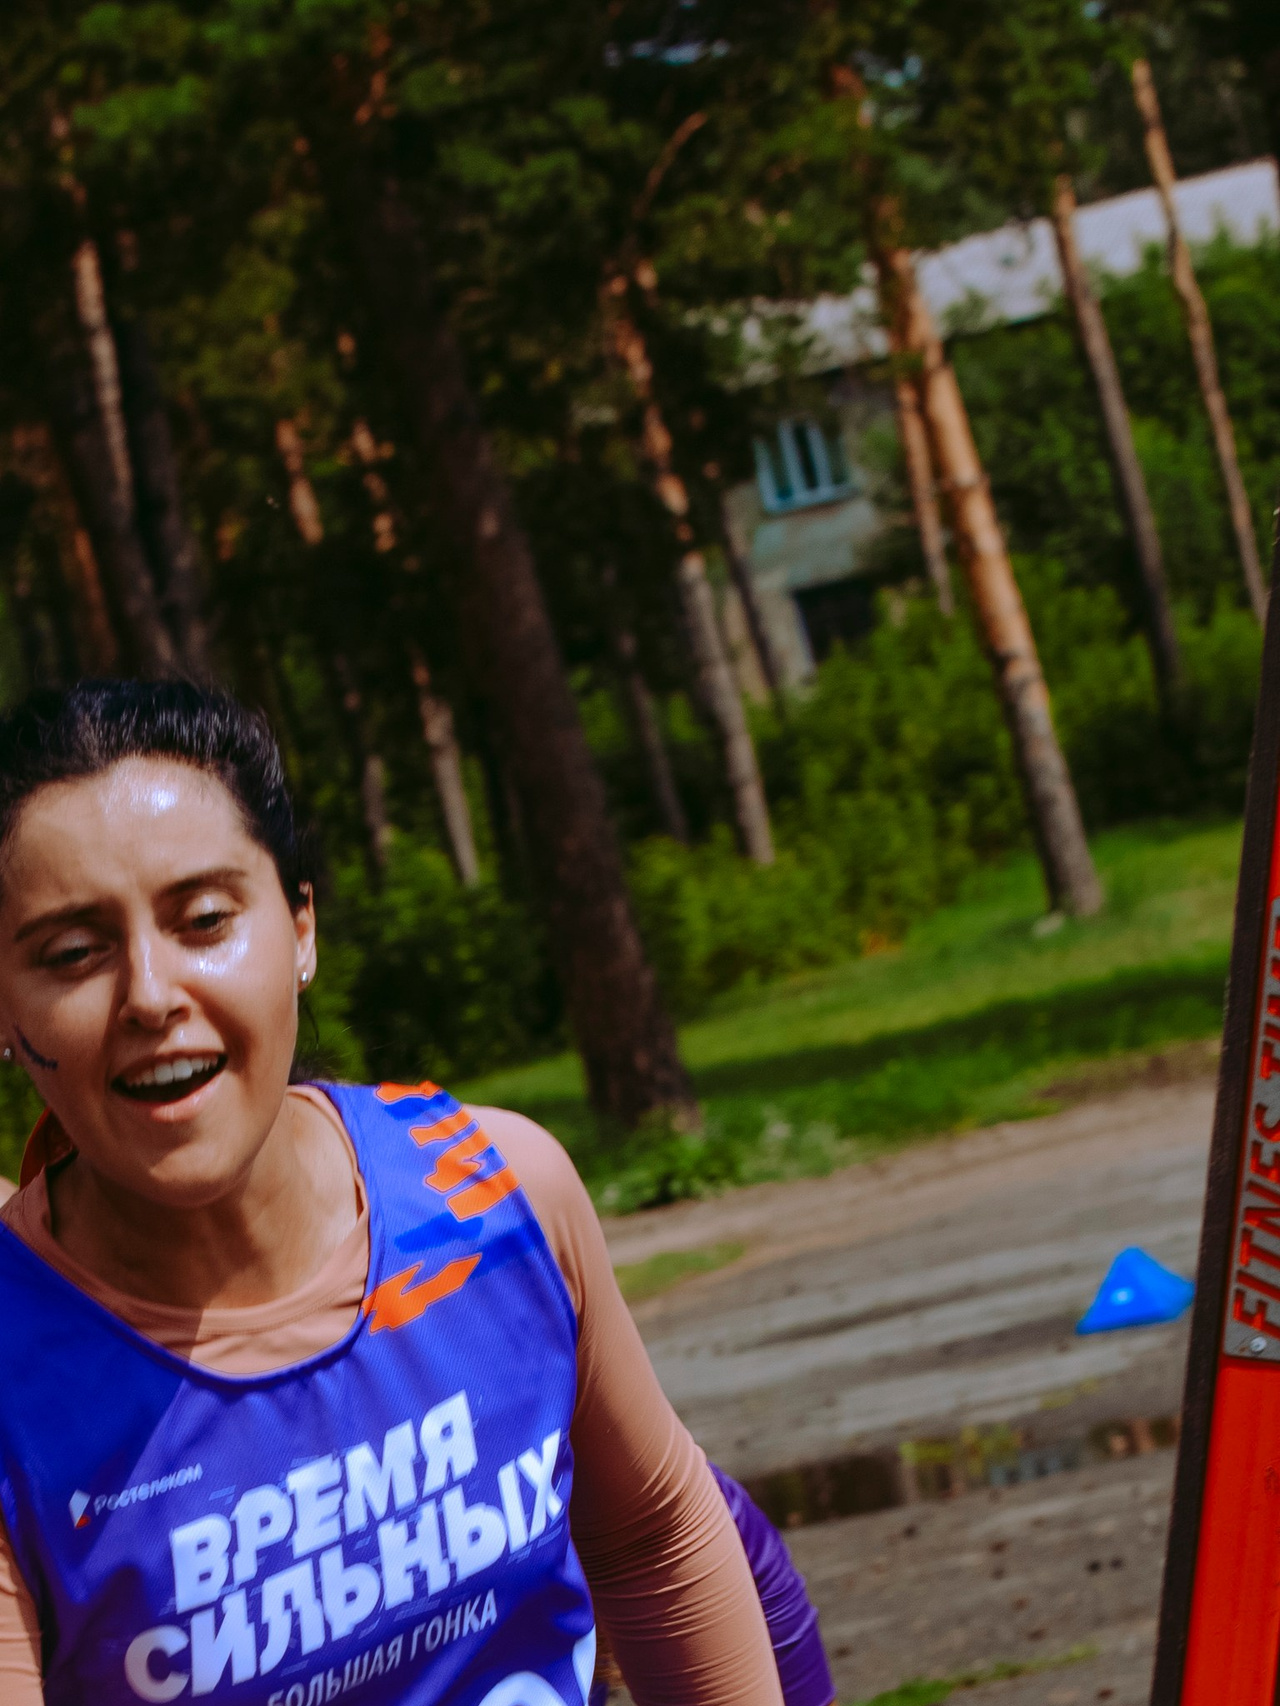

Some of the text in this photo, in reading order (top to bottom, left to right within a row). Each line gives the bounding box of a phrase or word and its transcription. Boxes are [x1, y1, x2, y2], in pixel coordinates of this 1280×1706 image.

[93, 1462, 204, 1516] Ростелеком
[170, 1389, 478, 1614] ВРЕМЯ
[124, 1428, 564, 1702] СИЛЬНЫХ
[410, 1588, 498, 1662] ГОНКА
